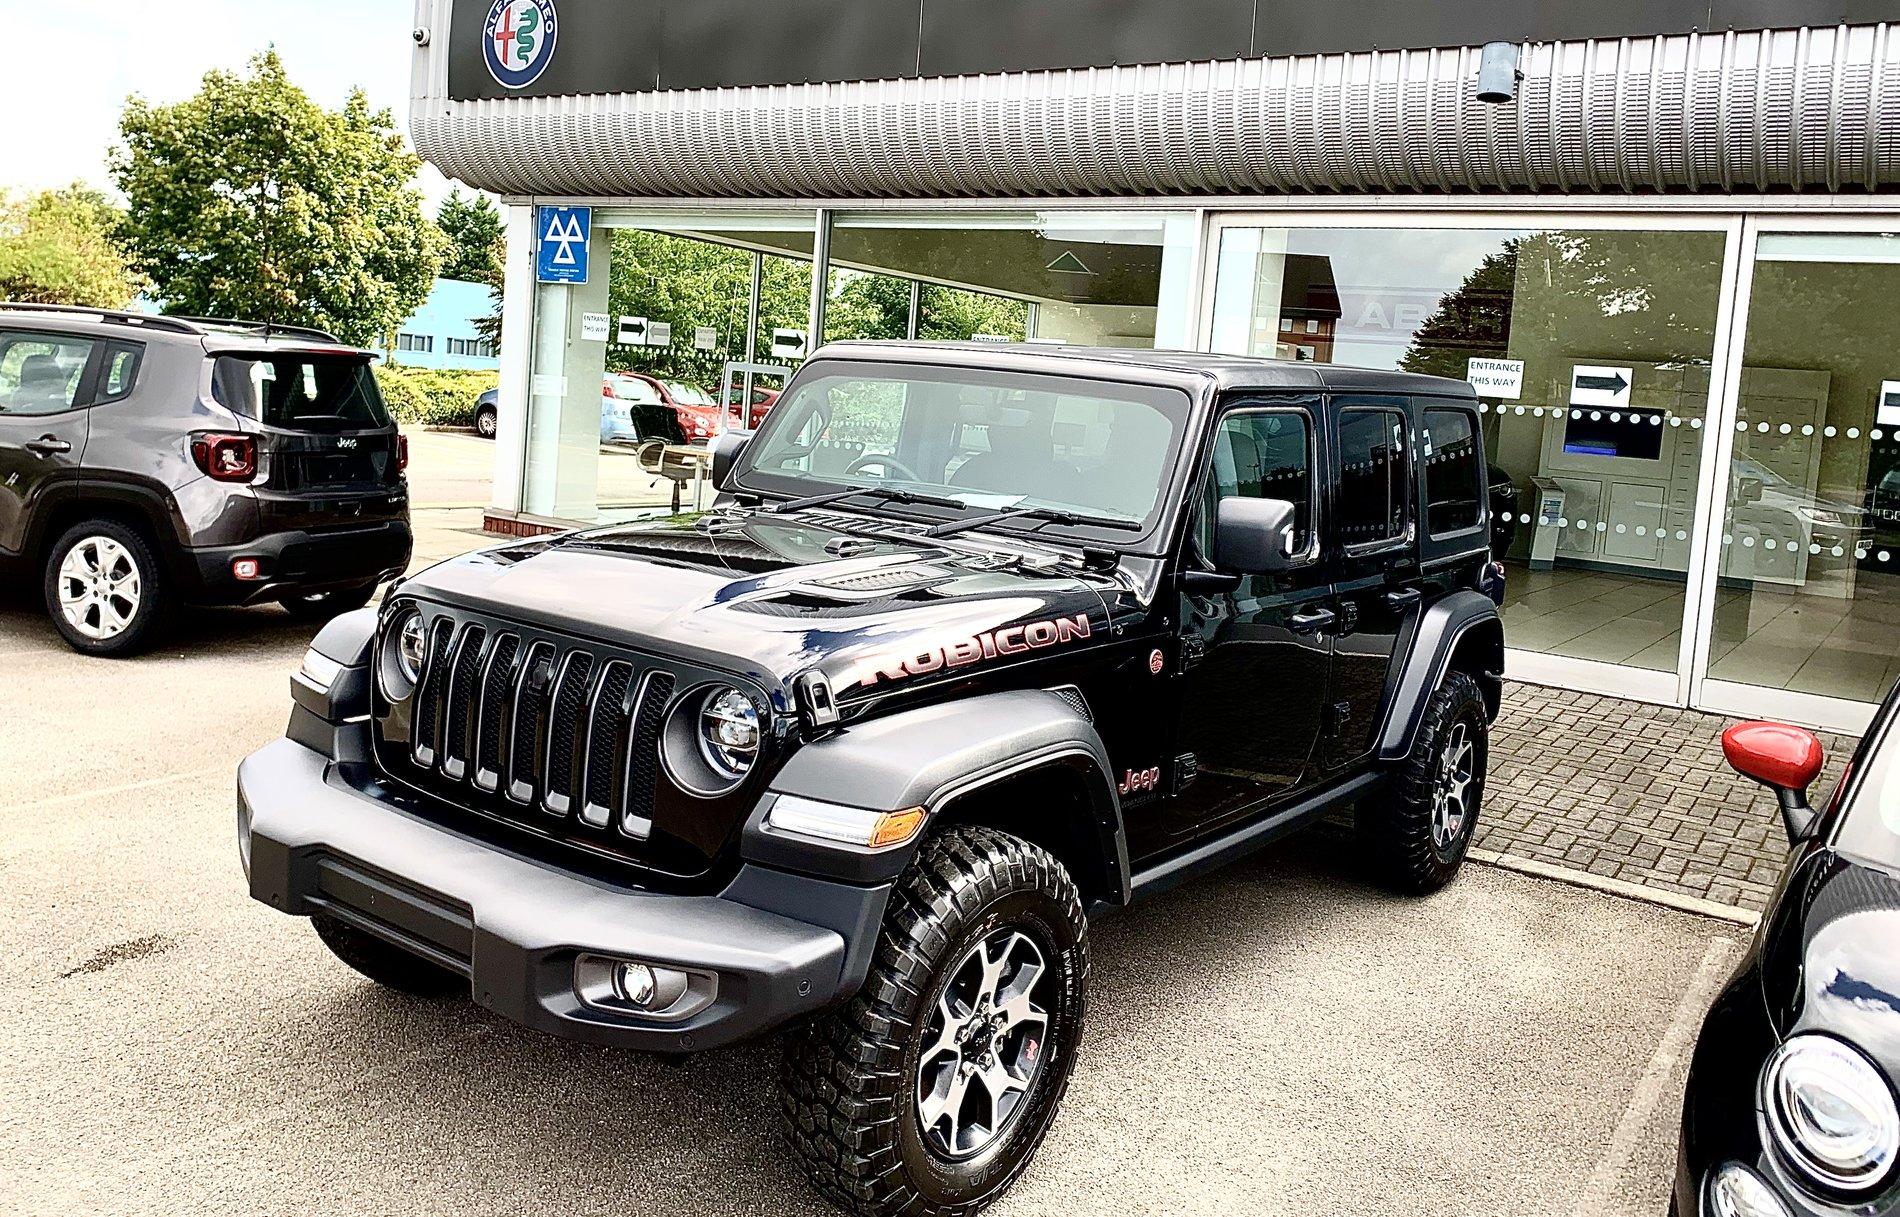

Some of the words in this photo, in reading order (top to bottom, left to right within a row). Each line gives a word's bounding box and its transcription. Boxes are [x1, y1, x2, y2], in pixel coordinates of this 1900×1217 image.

[1470, 361, 1521, 373] ENTRANCE
[1469, 375, 1490, 385] THIS
[1492, 377, 1516, 387] WAY
[854, 613, 1092, 687] RUBICON
[1118, 766, 1160, 795] Jeep
